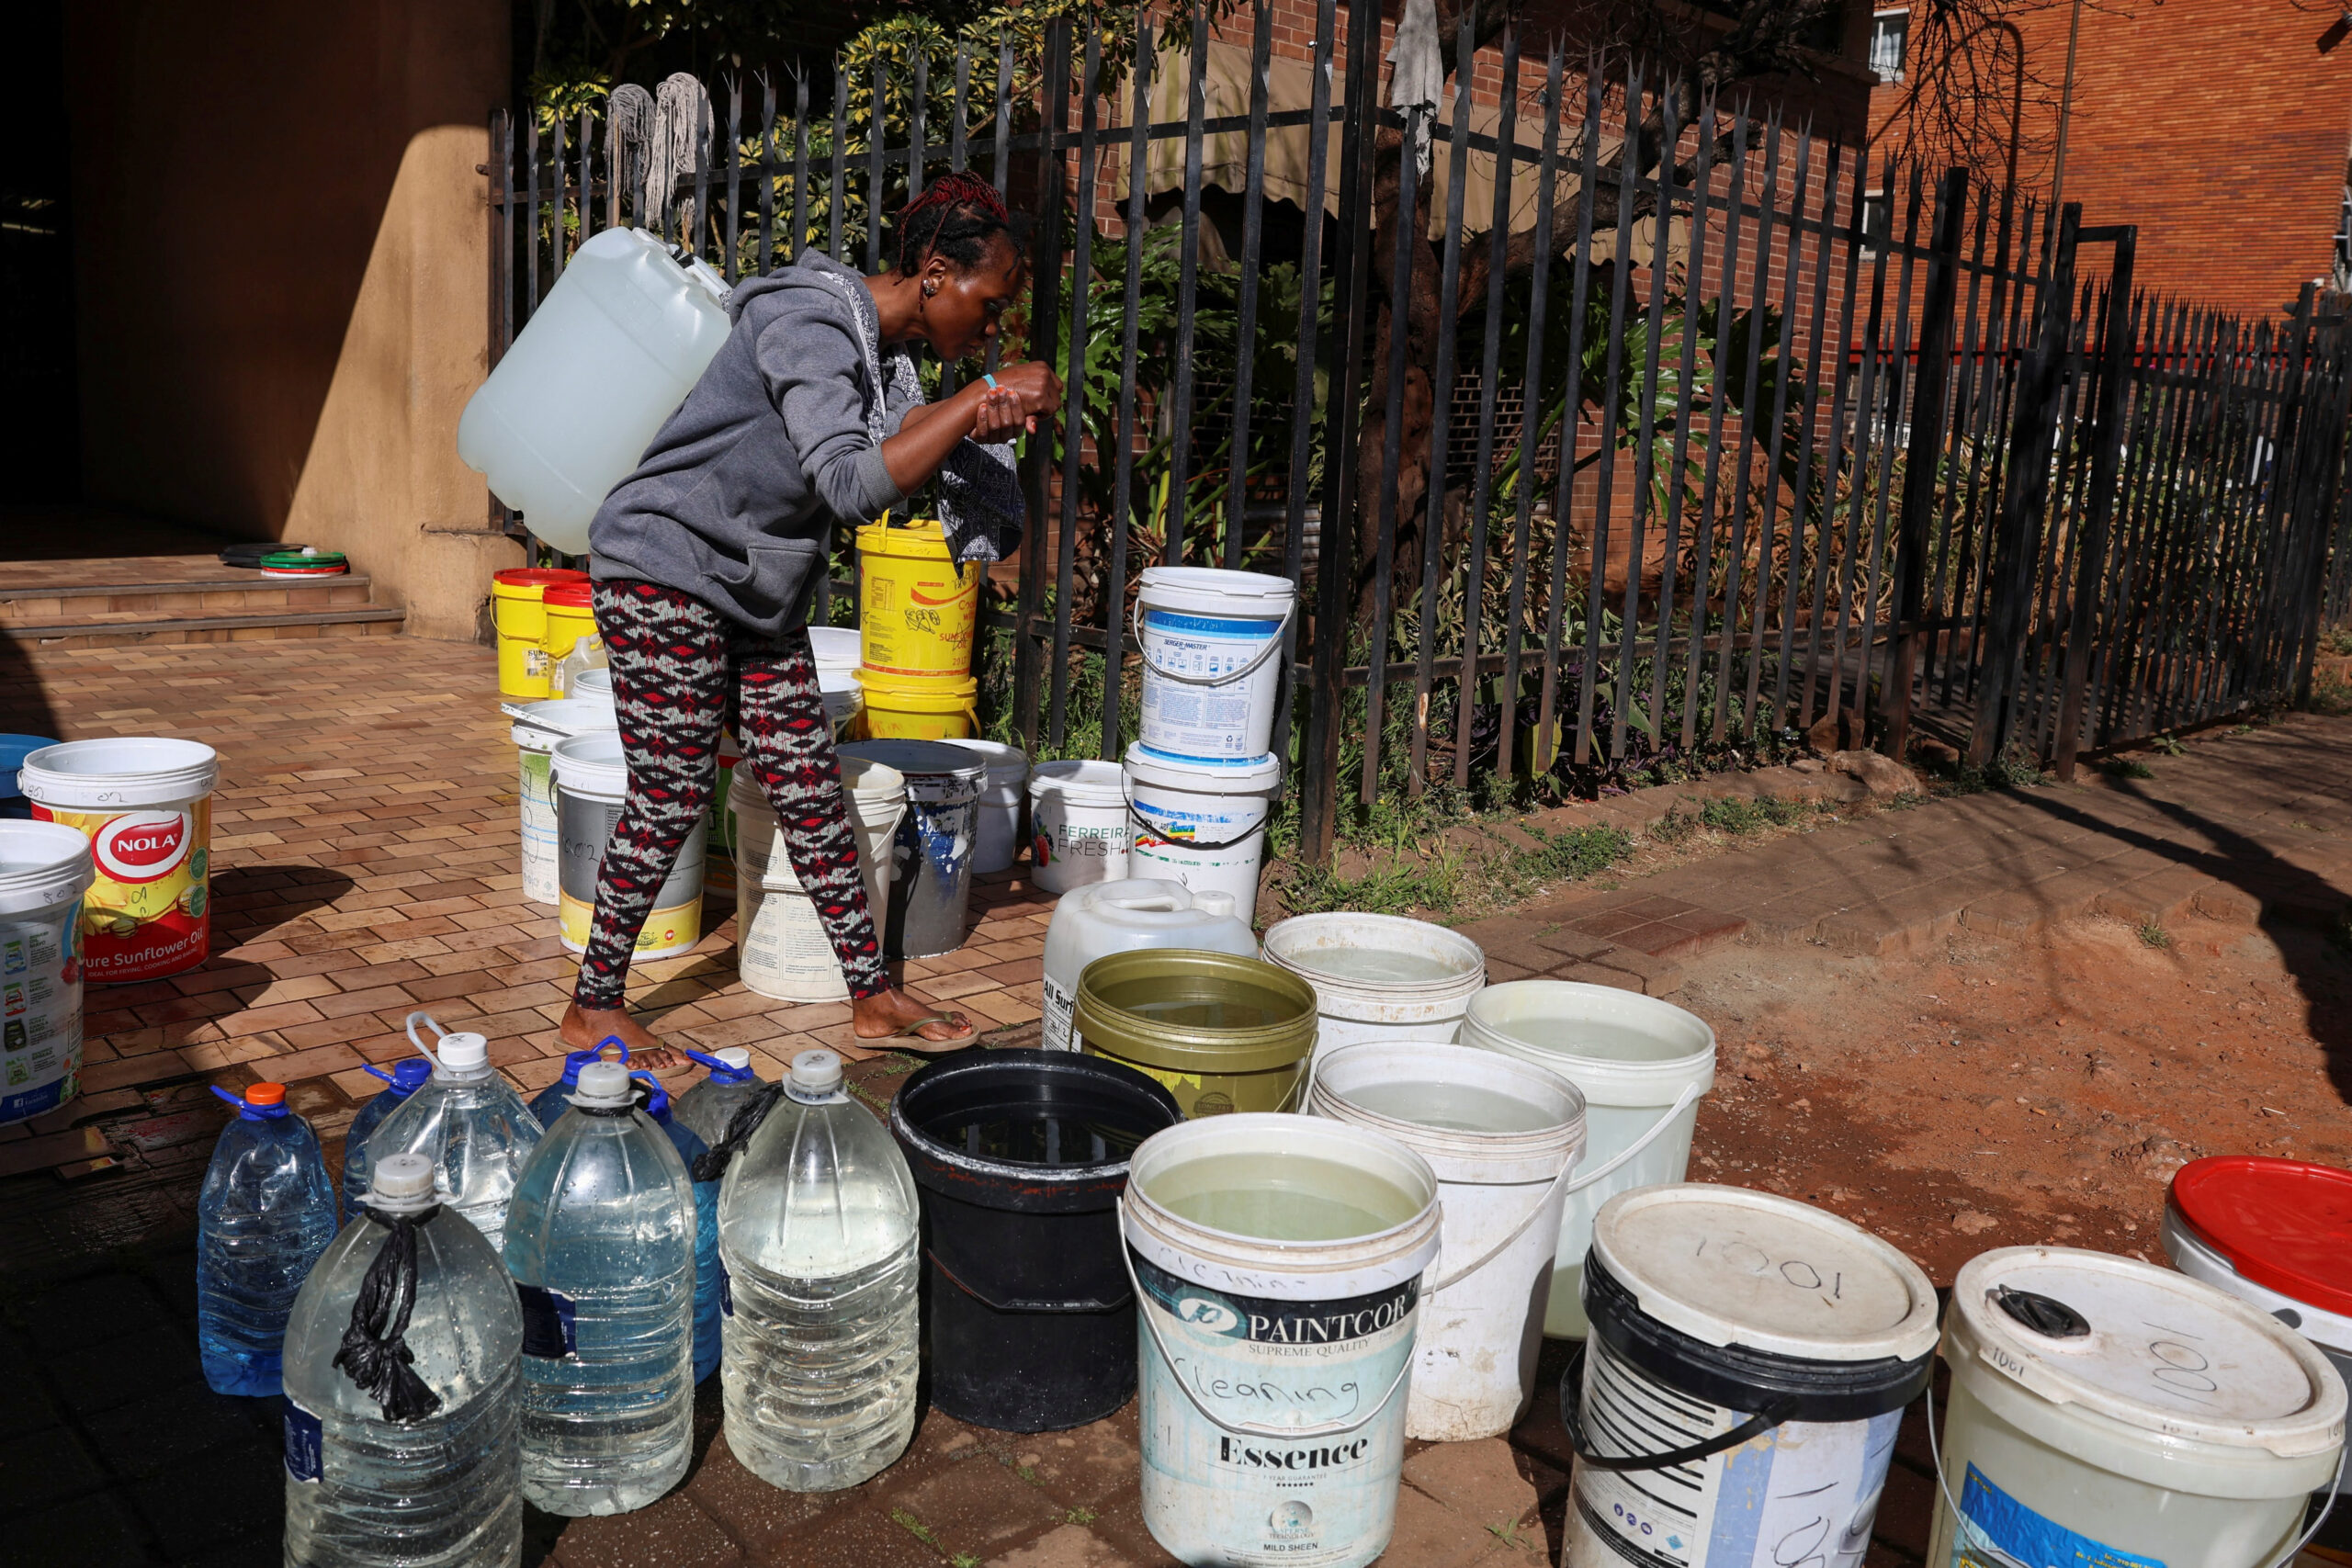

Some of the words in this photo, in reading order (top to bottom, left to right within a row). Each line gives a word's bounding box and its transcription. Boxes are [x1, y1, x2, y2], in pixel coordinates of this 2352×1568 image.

[118, 834, 175, 852] NOLA
[1057, 838, 1122, 857] FRESH
[84, 956, 109, 969] ure
[114, 937, 189, 966] Sunflower
[190, 926, 203, 944] Oil
[144, 960, 171, 971] COOKING
[171, 954, 182, 963] AND
[1044, 980, 1054, 999] All
[1248, 1293, 1406, 1344] PAINTCOR
[1249, 1343, 1314, 1358] SUPREME
[1317, 1337, 1371, 1358] QUALITY
[1220, 1436, 1368, 1471] Essence
[1288, 1472, 1328, 1481] GUARANTEE
[1263, 1543, 1286, 1551] MILD
[1288, 1542, 1318, 1552] SHEEN
